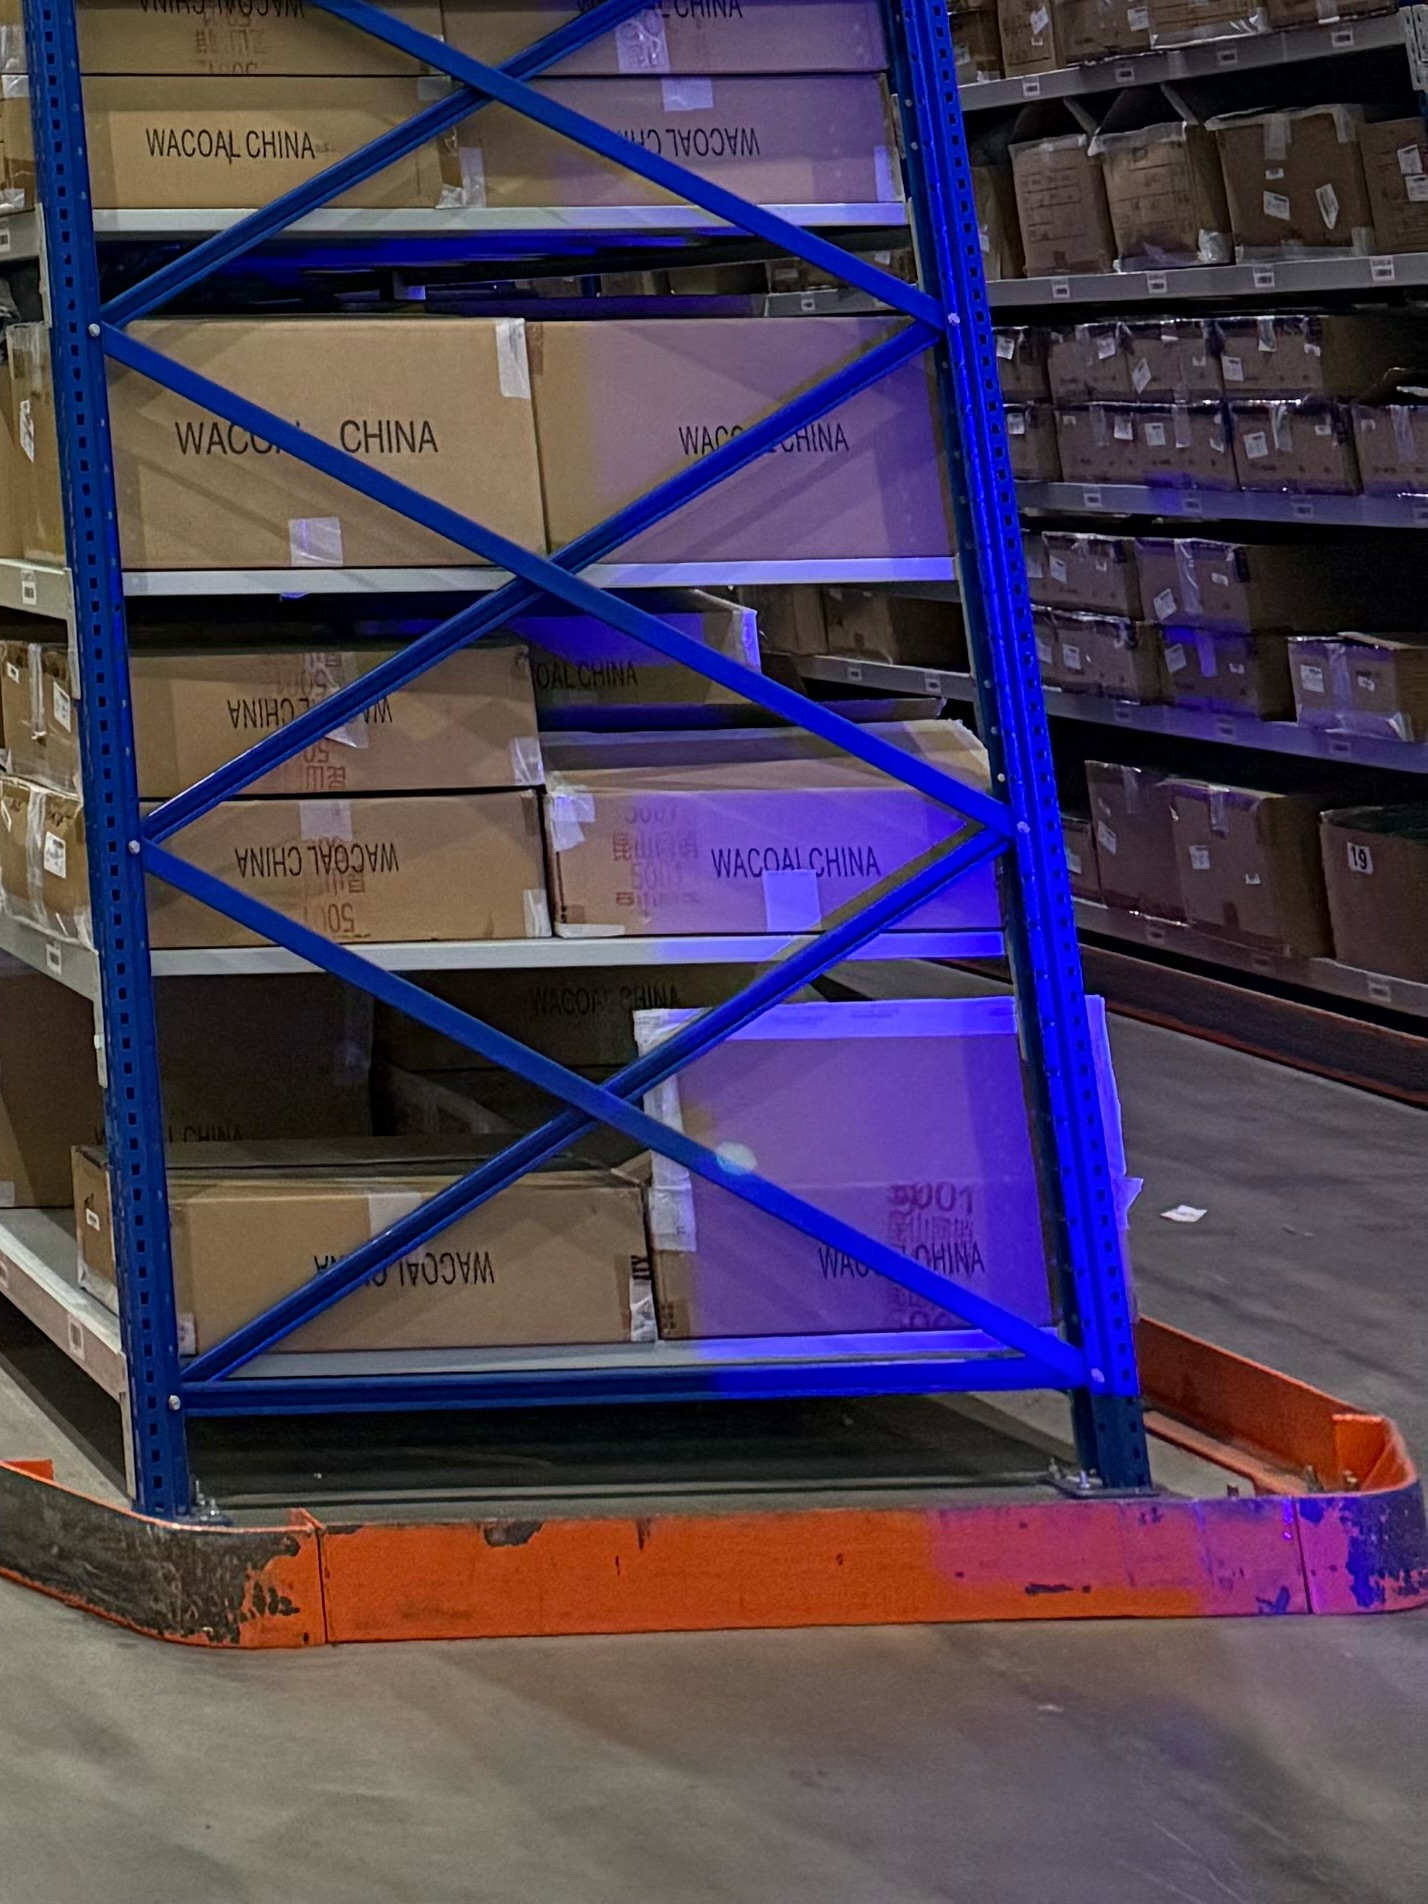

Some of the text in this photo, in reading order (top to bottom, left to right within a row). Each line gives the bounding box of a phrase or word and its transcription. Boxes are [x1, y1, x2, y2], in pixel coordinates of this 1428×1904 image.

[146, 129, 315, 161] WACOAL CHINA
[667, 127, 760, 157] WACOAL
[340, 420, 438, 454] CHINA
[236, 844, 399, 878] WACOAL CHINA
[810, 846, 882, 877] CHINA
[1351, 847, 1369, 870] 19
